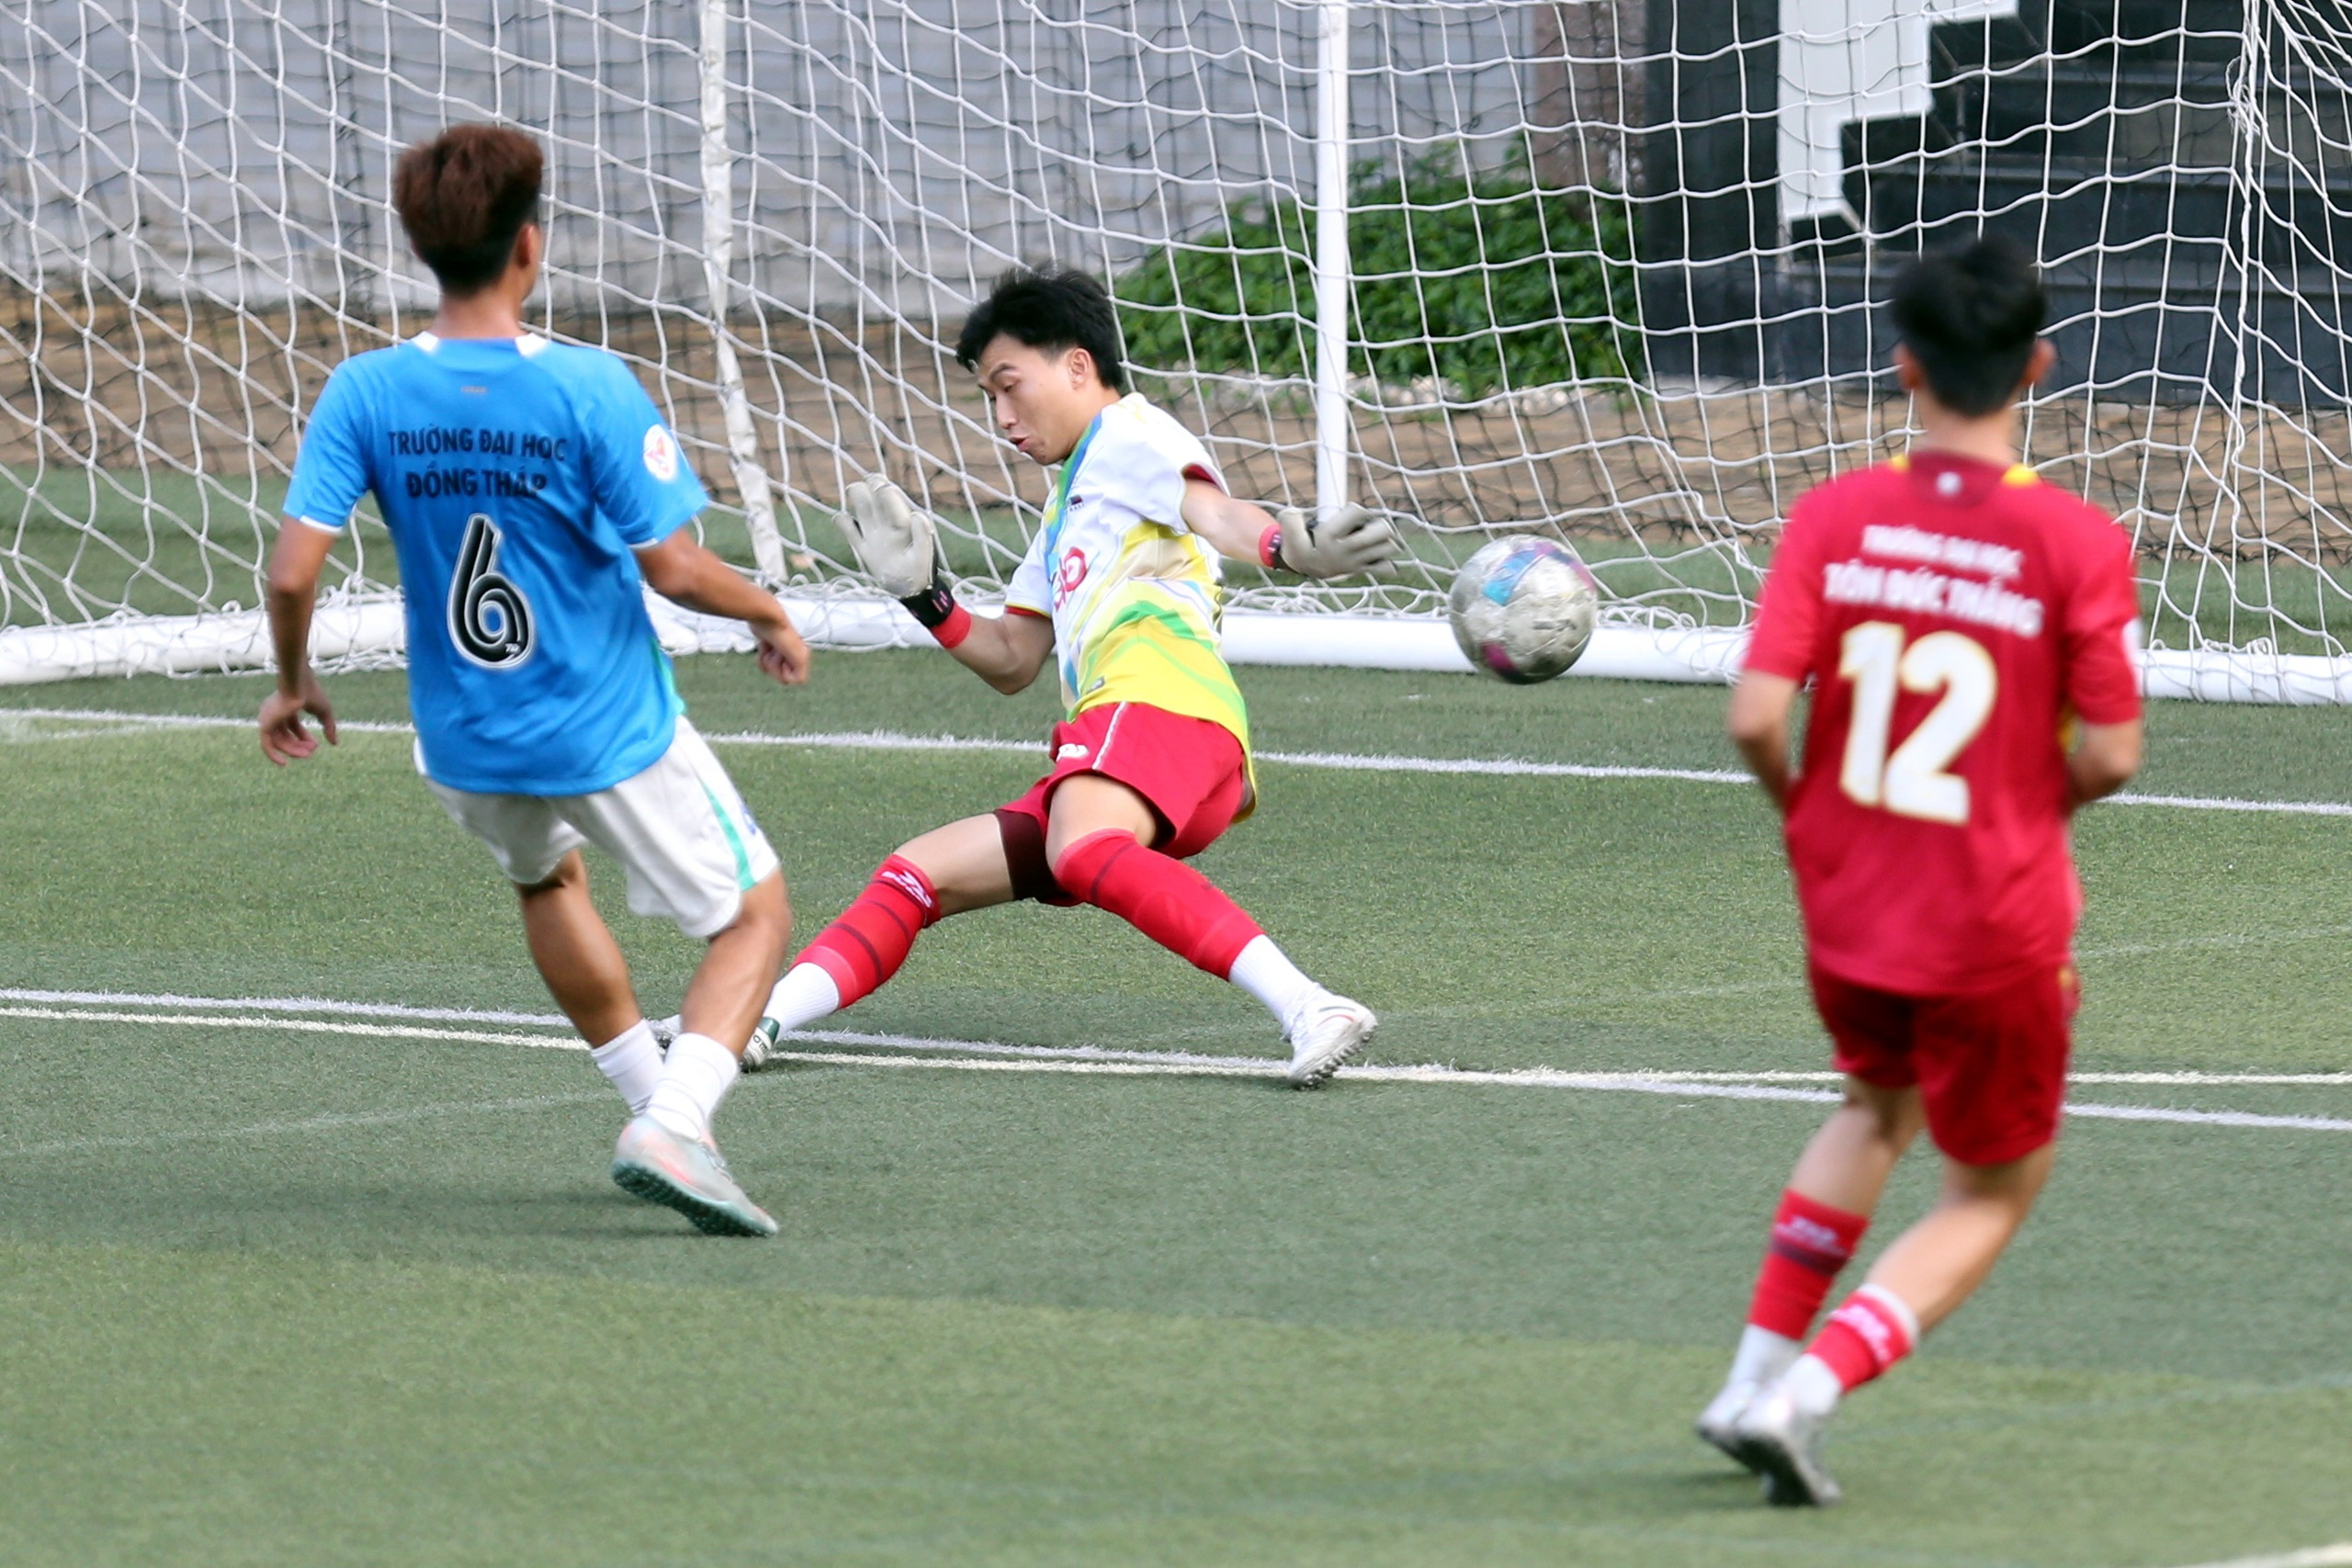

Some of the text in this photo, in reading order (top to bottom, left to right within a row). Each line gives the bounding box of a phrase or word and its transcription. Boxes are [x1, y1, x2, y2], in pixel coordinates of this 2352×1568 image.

[388, 423, 568, 465] TRƯỜNG ĐẠI HỌC
[481, 466, 548, 499] THÁP
[447, 513, 535, 669] 6
[1838, 620, 1998, 825] 12
